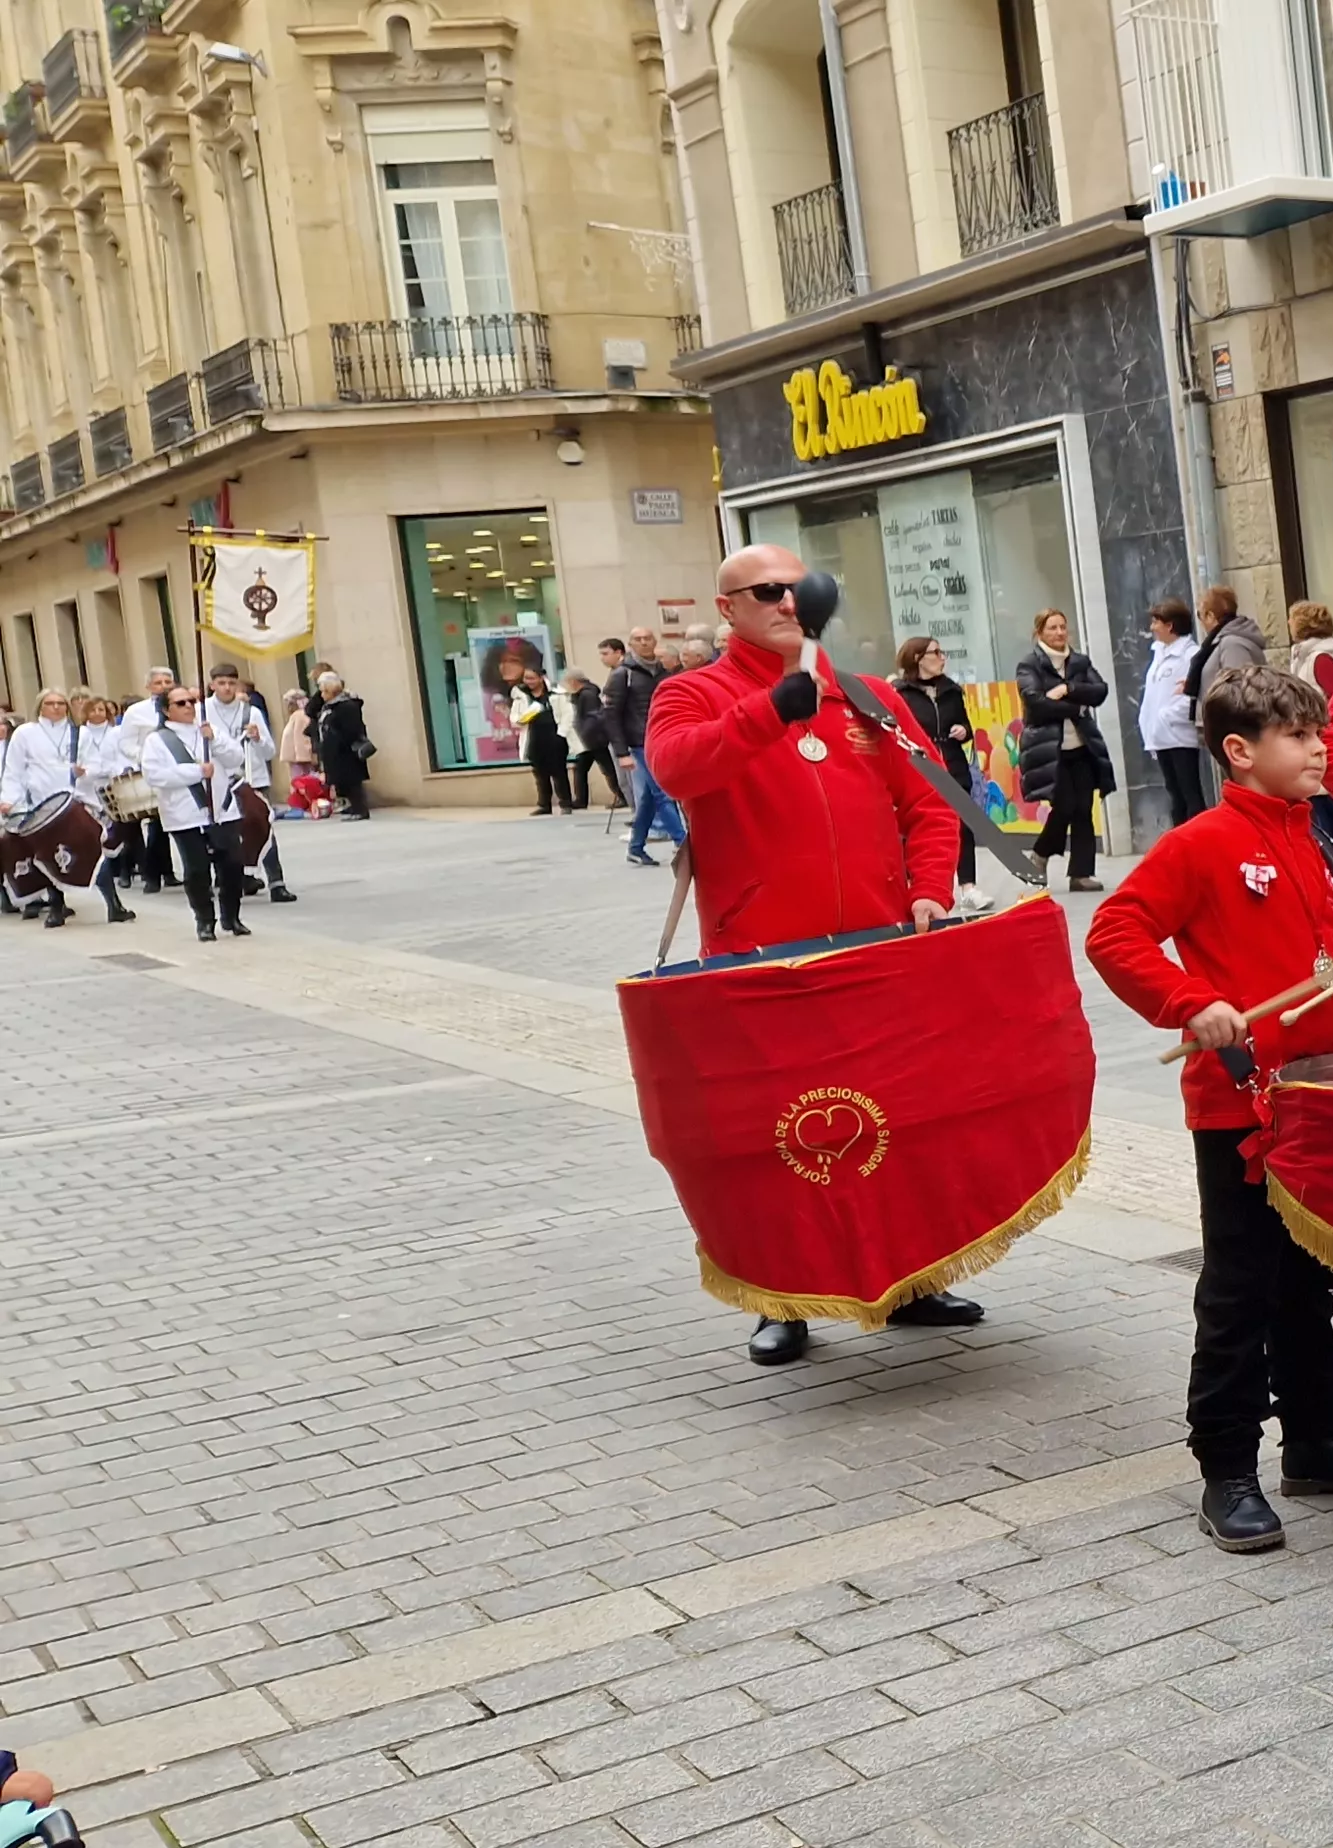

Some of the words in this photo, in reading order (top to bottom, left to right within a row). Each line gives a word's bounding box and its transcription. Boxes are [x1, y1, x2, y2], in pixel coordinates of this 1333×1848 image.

[783, 367, 825, 461] El
[818, 359, 927, 454] Rincón
[781, 1102, 802, 1120] LA
[799, 1086, 888, 1127] PRECIOSISIMA
[775, 1120, 789, 1138] DE
[775, 1141, 831, 1185] COFRADIA
[857, 1129, 890, 1177] SANGRE
